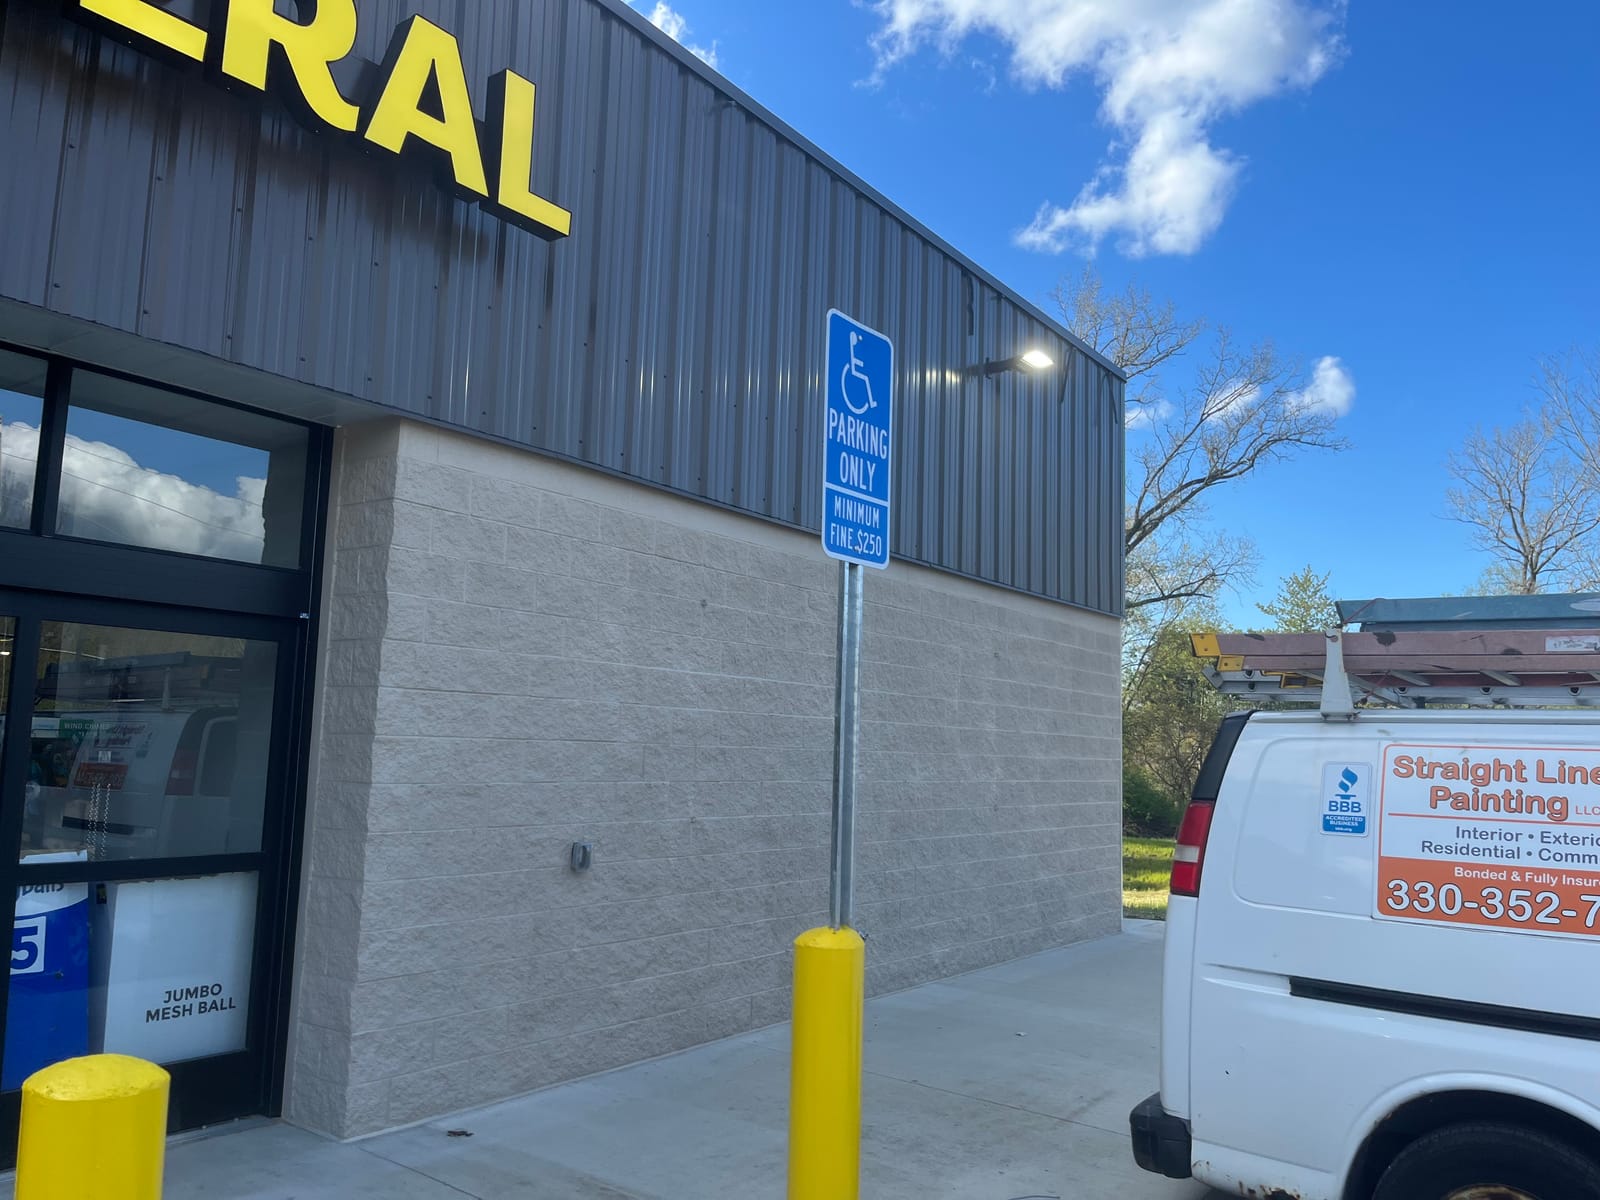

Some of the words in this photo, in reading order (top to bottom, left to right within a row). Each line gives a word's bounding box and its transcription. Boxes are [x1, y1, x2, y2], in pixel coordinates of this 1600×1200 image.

[80, 0, 572, 236] RAL
[829, 407, 888, 460] PARKING
[839, 452, 876, 492] ONLY
[834, 495, 880, 529] MINIMUM
[830, 522, 853, 550] FINE
[857, 529, 882, 557] $250
[1393, 755, 1528, 787] Straight
[1328, 800, 1361, 813] BBB
[1429, 785, 1569, 822] Painting
[1575, 804, 1600, 816] LLC
[1421, 840, 1521, 860] Residential
[1456, 826, 1523, 843] Interior
[1454, 866, 1507, 882] Bonded
[1511, 871, 1521, 882] &
[1525, 872, 1558, 886] Fully
[1562, 874, 1600, 887] Insur
[1386, 878, 1600, 928] 330-352-7
[145, 1003, 193, 1023] MESH
[198, 997, 236, 1015] BALL
[163, 983, 223, 1004] JUMBO
